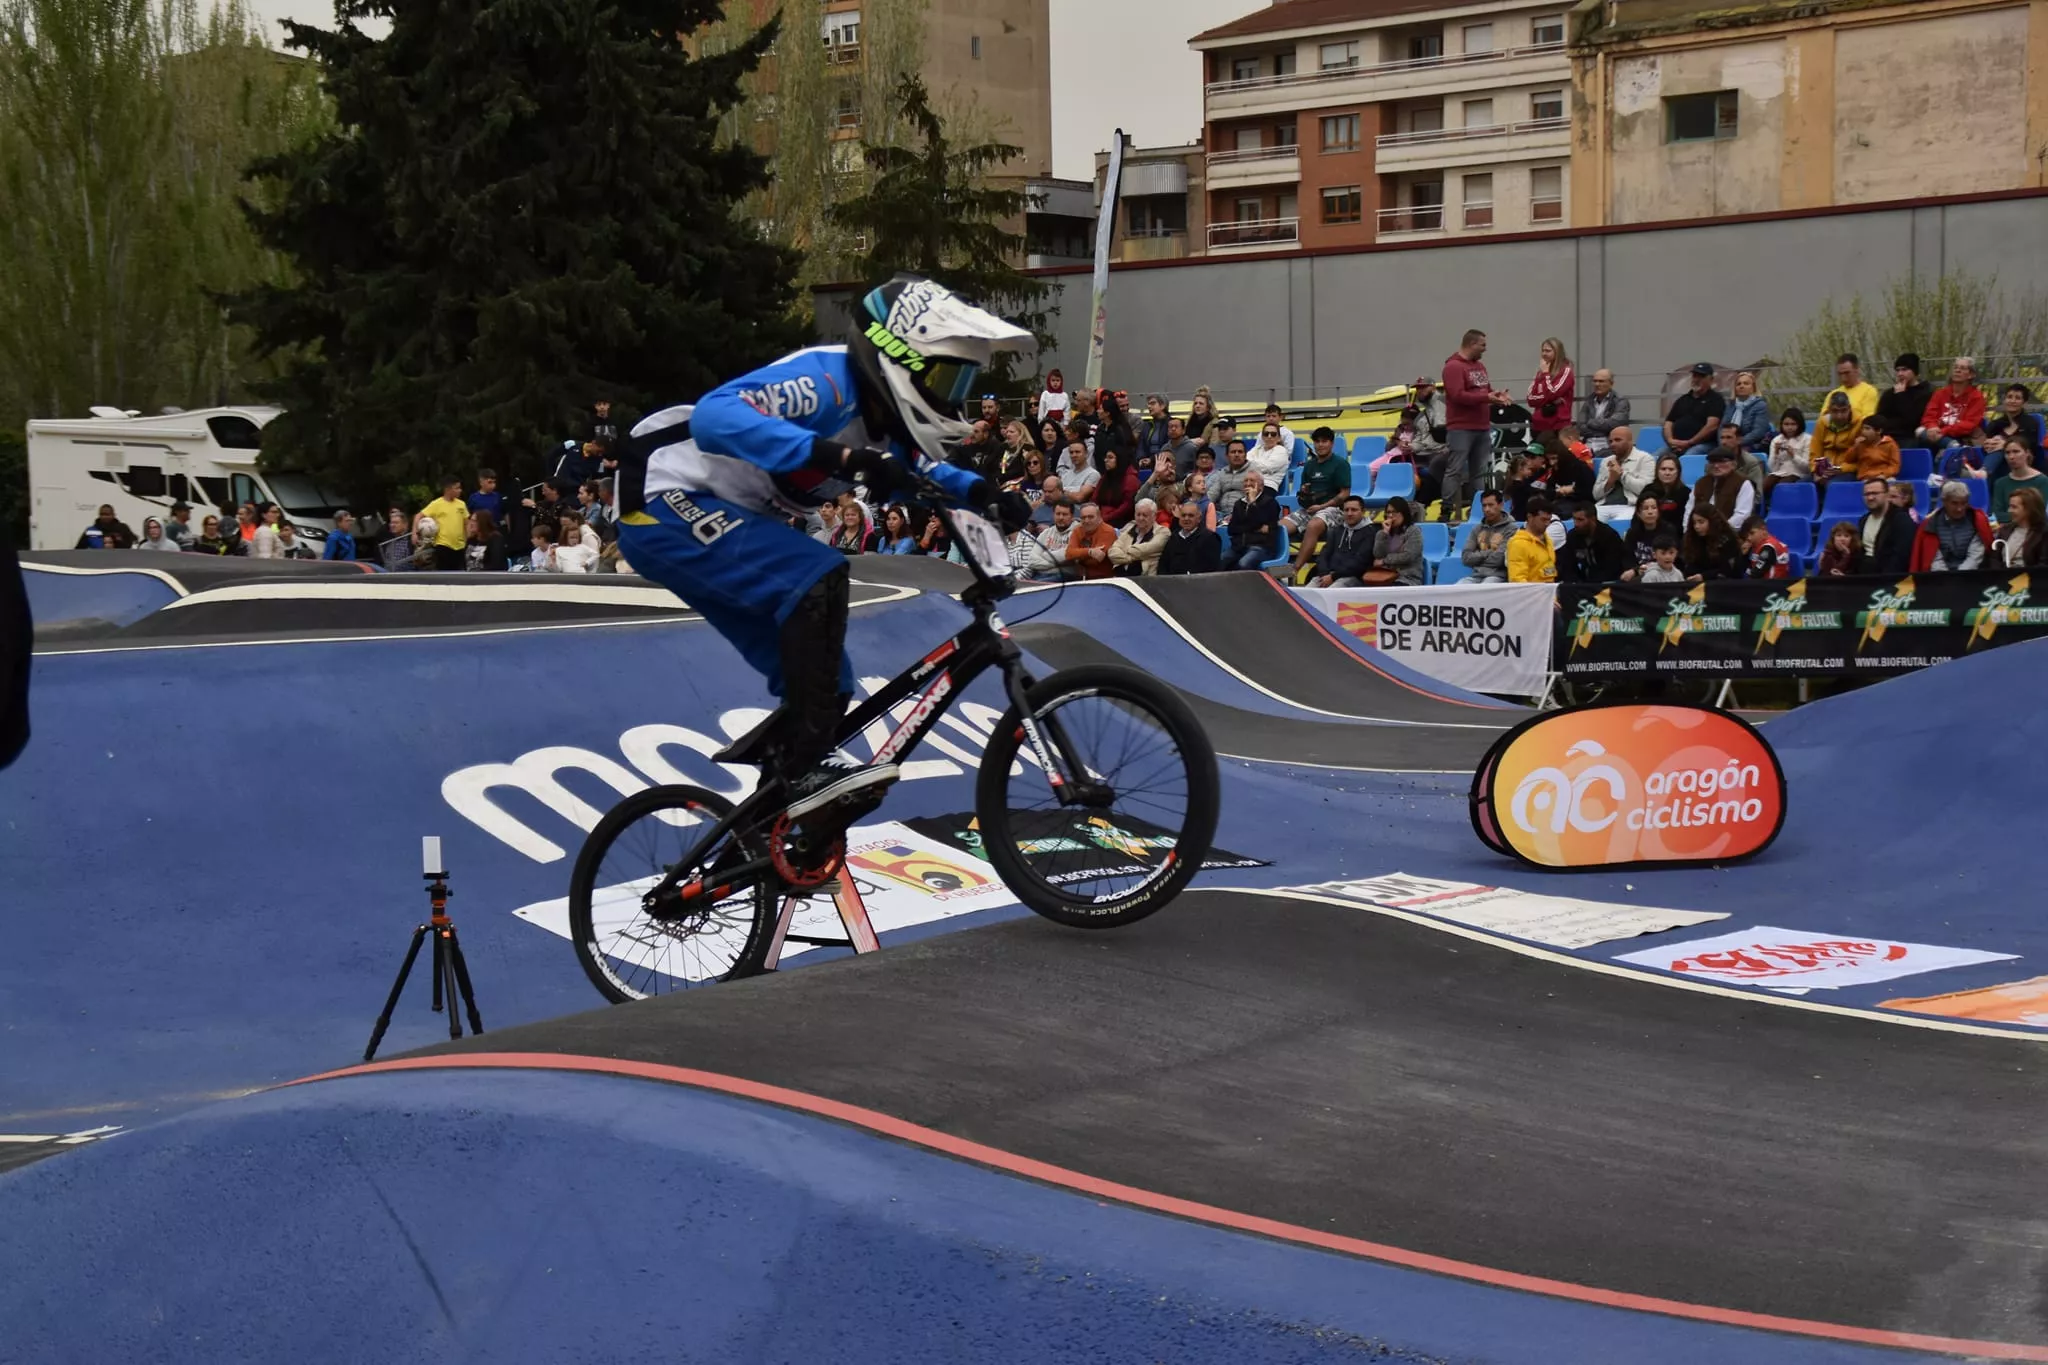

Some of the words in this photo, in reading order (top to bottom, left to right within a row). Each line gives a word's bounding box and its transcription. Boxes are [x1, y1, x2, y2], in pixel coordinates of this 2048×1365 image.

[864, 320, 926, 372] 100%
[1577, 598, 1613, 624] Sport
[1666, 597, 1707, 622] Sport
[1762, 592, 1808, 618] Sport
[1868, 588, 1916, 616] Sport
[1979, 585, 2030, 612] Sport
[1380, 603, 1506, 631] GOBIERNO
[1380, 628, 1412, 651] DE
[1420, 630, 1522, 658] ARAGON
[1566, 660, 1647, 673] WWW.BIOFRUTAL.COM
[1656, 659, 1743, 670] WWW.BIOFRUTAL.COM
[1752, 658, 1845, 669] WWW.BIOFRUTAL.COM
[1645, 758, 1760, 798] aragón
[1626, 798, 1763, 831] ciclismo
